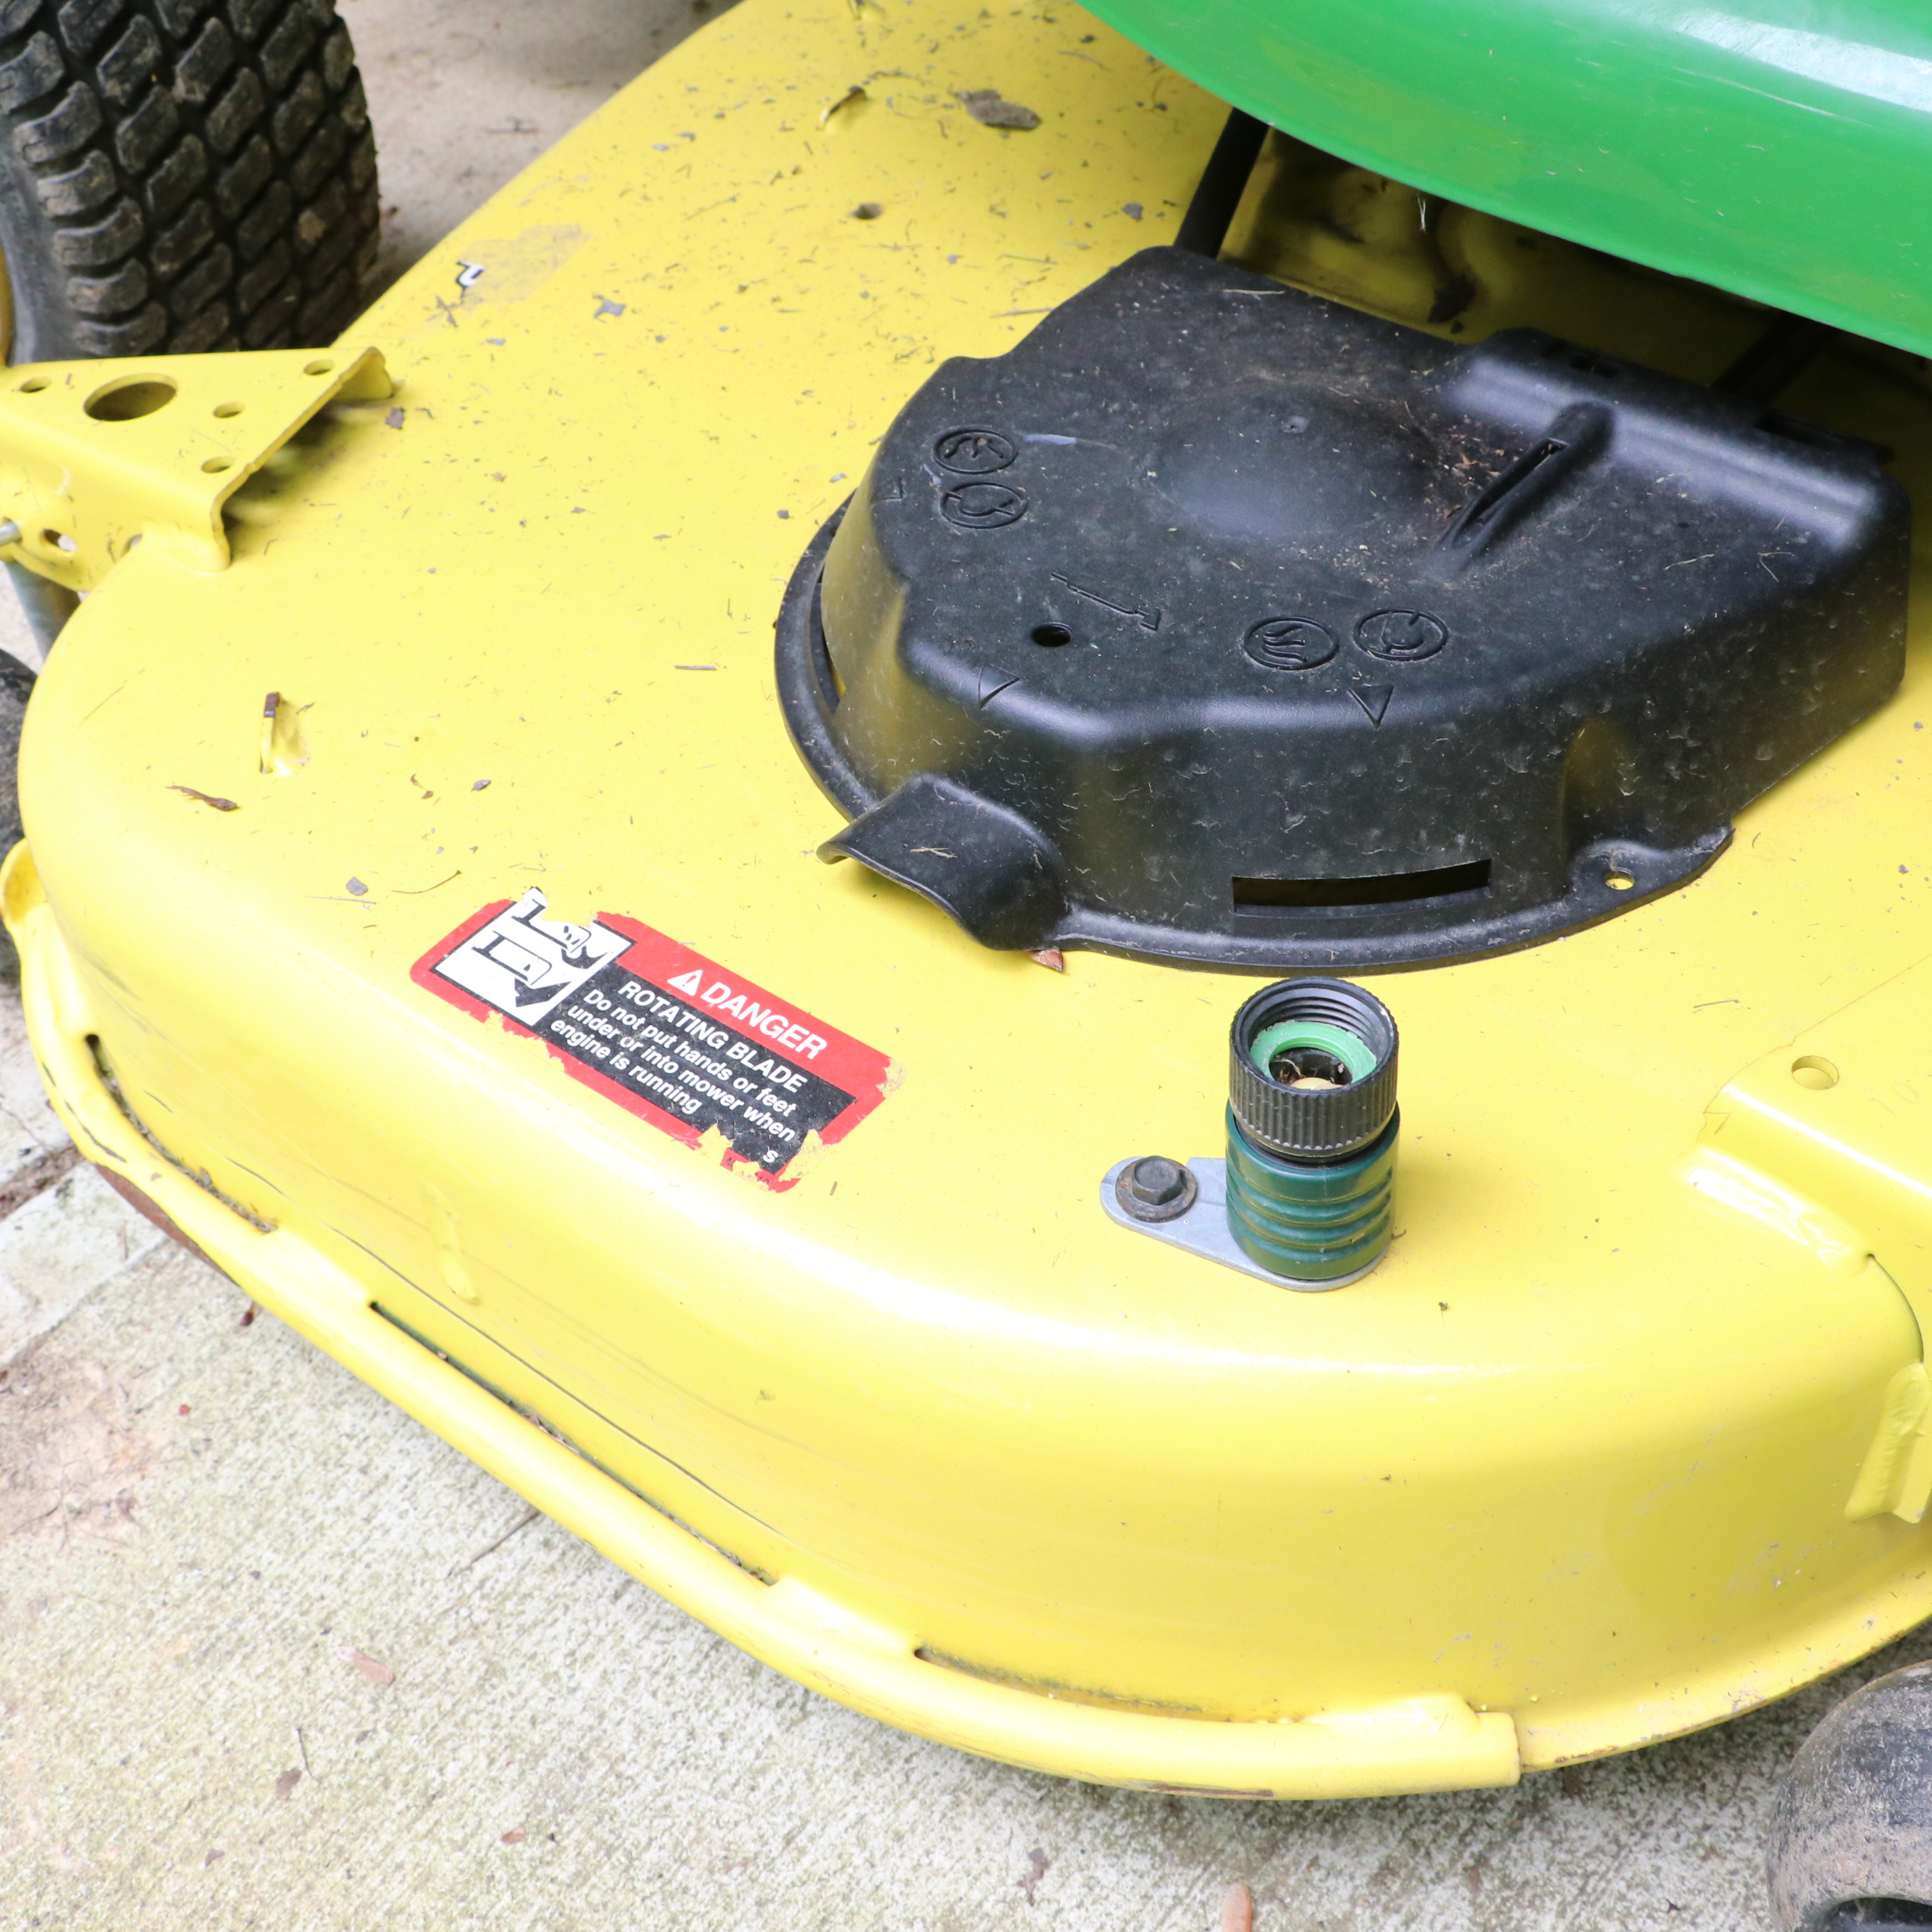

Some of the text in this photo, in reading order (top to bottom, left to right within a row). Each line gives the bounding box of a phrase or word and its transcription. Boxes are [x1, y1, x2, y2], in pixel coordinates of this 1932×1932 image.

[550, 1020, 703, 1114] engine is running
[567, 1005, 796, 1142] under or into mower when
[583, 989, 797, 1117] Do not put hands or feet
[618, 981, 808, 1093] ROTATING BLADE
[700, 981, 828, 1060] DANGER
